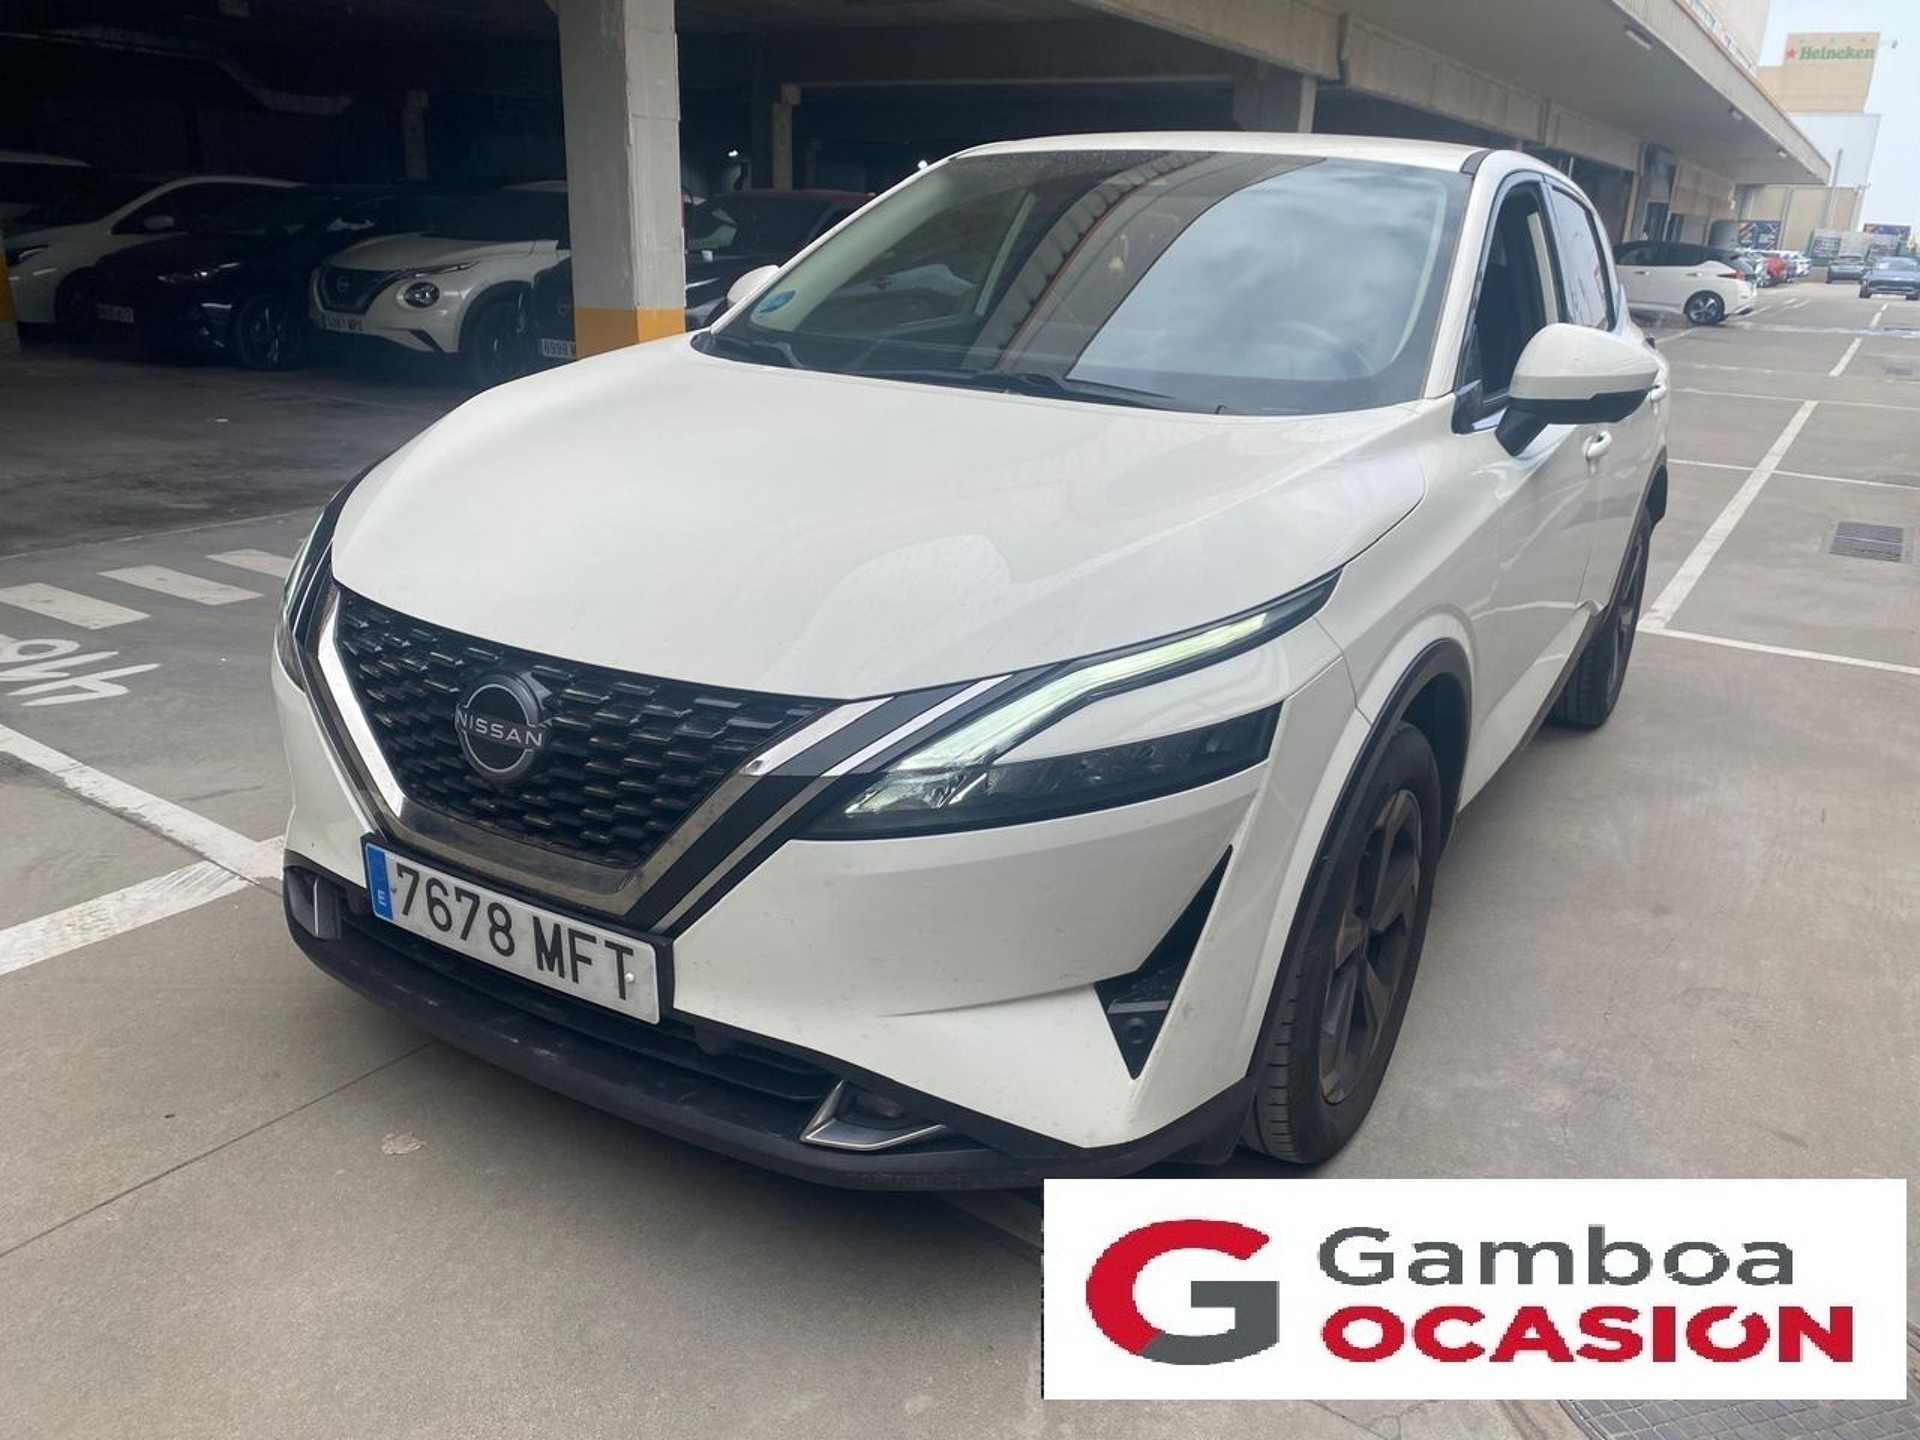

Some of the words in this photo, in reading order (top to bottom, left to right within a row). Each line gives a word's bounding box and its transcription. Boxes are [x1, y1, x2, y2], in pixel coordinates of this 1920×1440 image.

[1799, 46, 1875, 60] Heineken
[457, 709, 543, 747] NISSAN
[377, 888, 387, 906] E
[396, 862, 515, 957] 7678
[532, 915, 634, 1001] MFT
